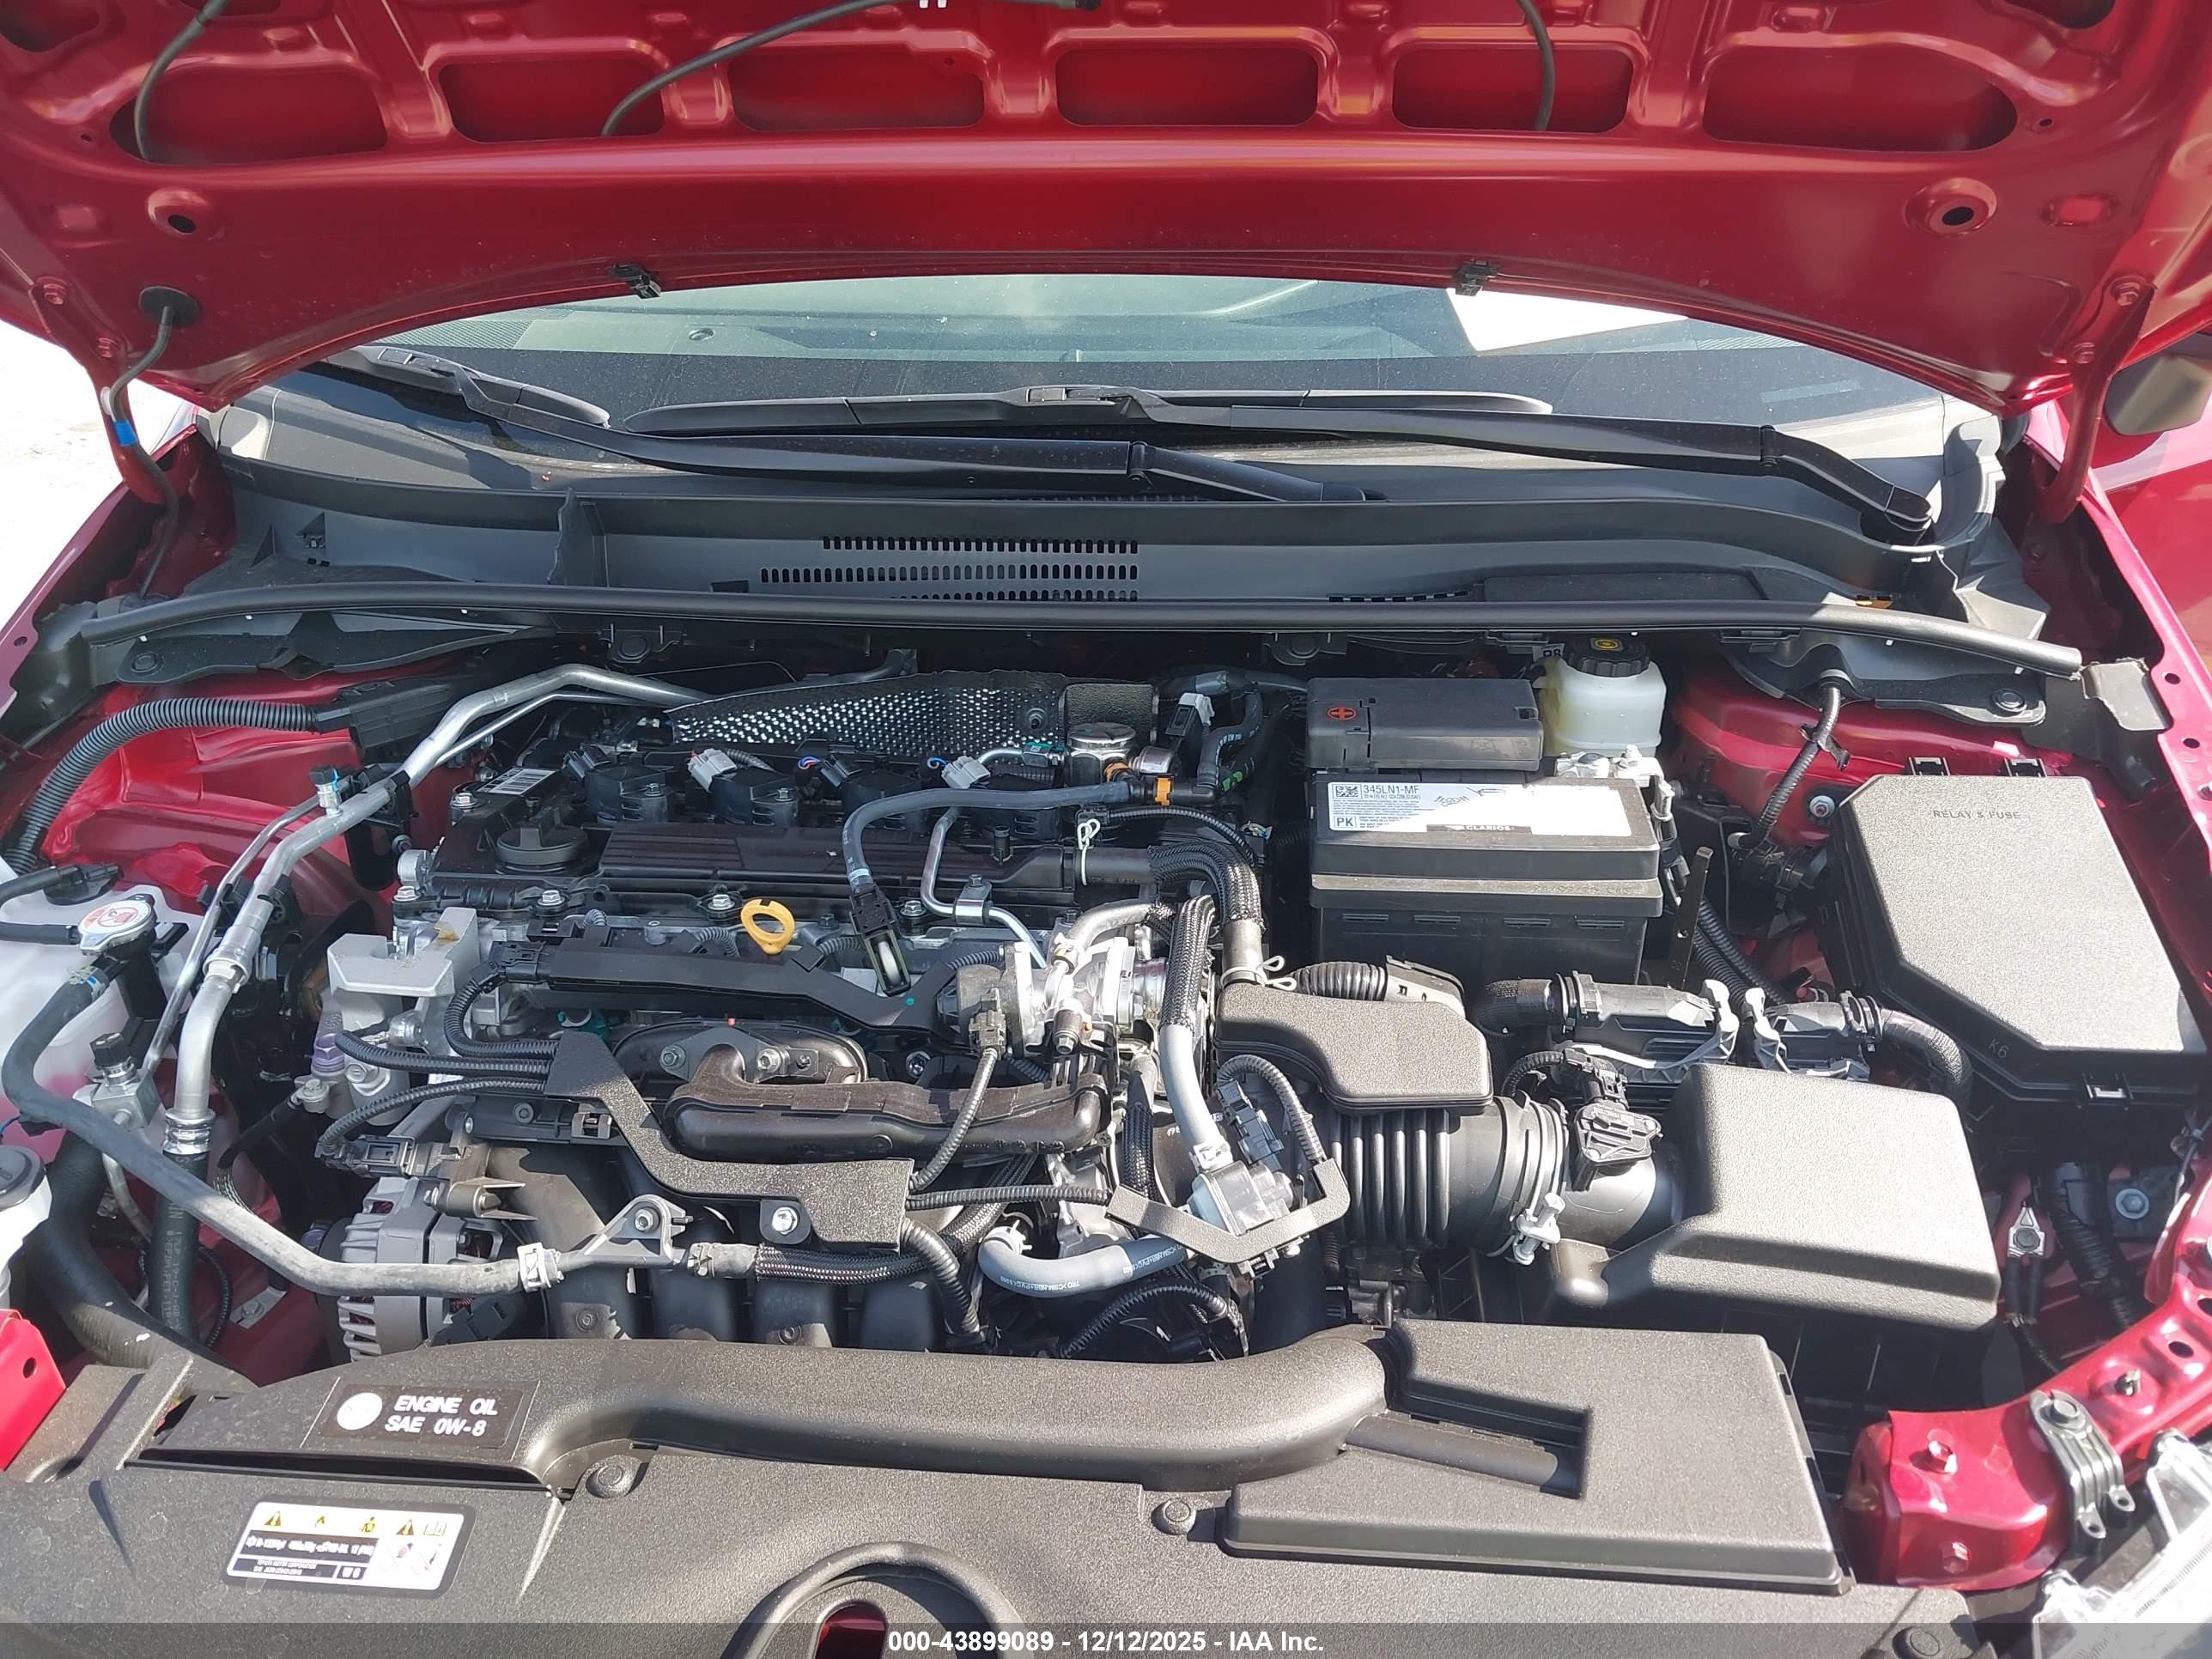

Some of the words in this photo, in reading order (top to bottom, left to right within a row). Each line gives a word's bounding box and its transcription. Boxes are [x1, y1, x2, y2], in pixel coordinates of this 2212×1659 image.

[1363, 784, 1420, 794] 345LN1-MF
[1932, 810, 1972, 819] RELAY
[1976, 811, 1984, 819] &
[1988, 811, 2022, 819] FUSE
[1336, 817, 1354, 827] PK
[393, 1395, 463, 1413] ENGINE
[469, 1398, 499, 1416] OIL
[385, 1415, 426, 1433] SAE
[433, 1418, 488, 1437] 0W-8
